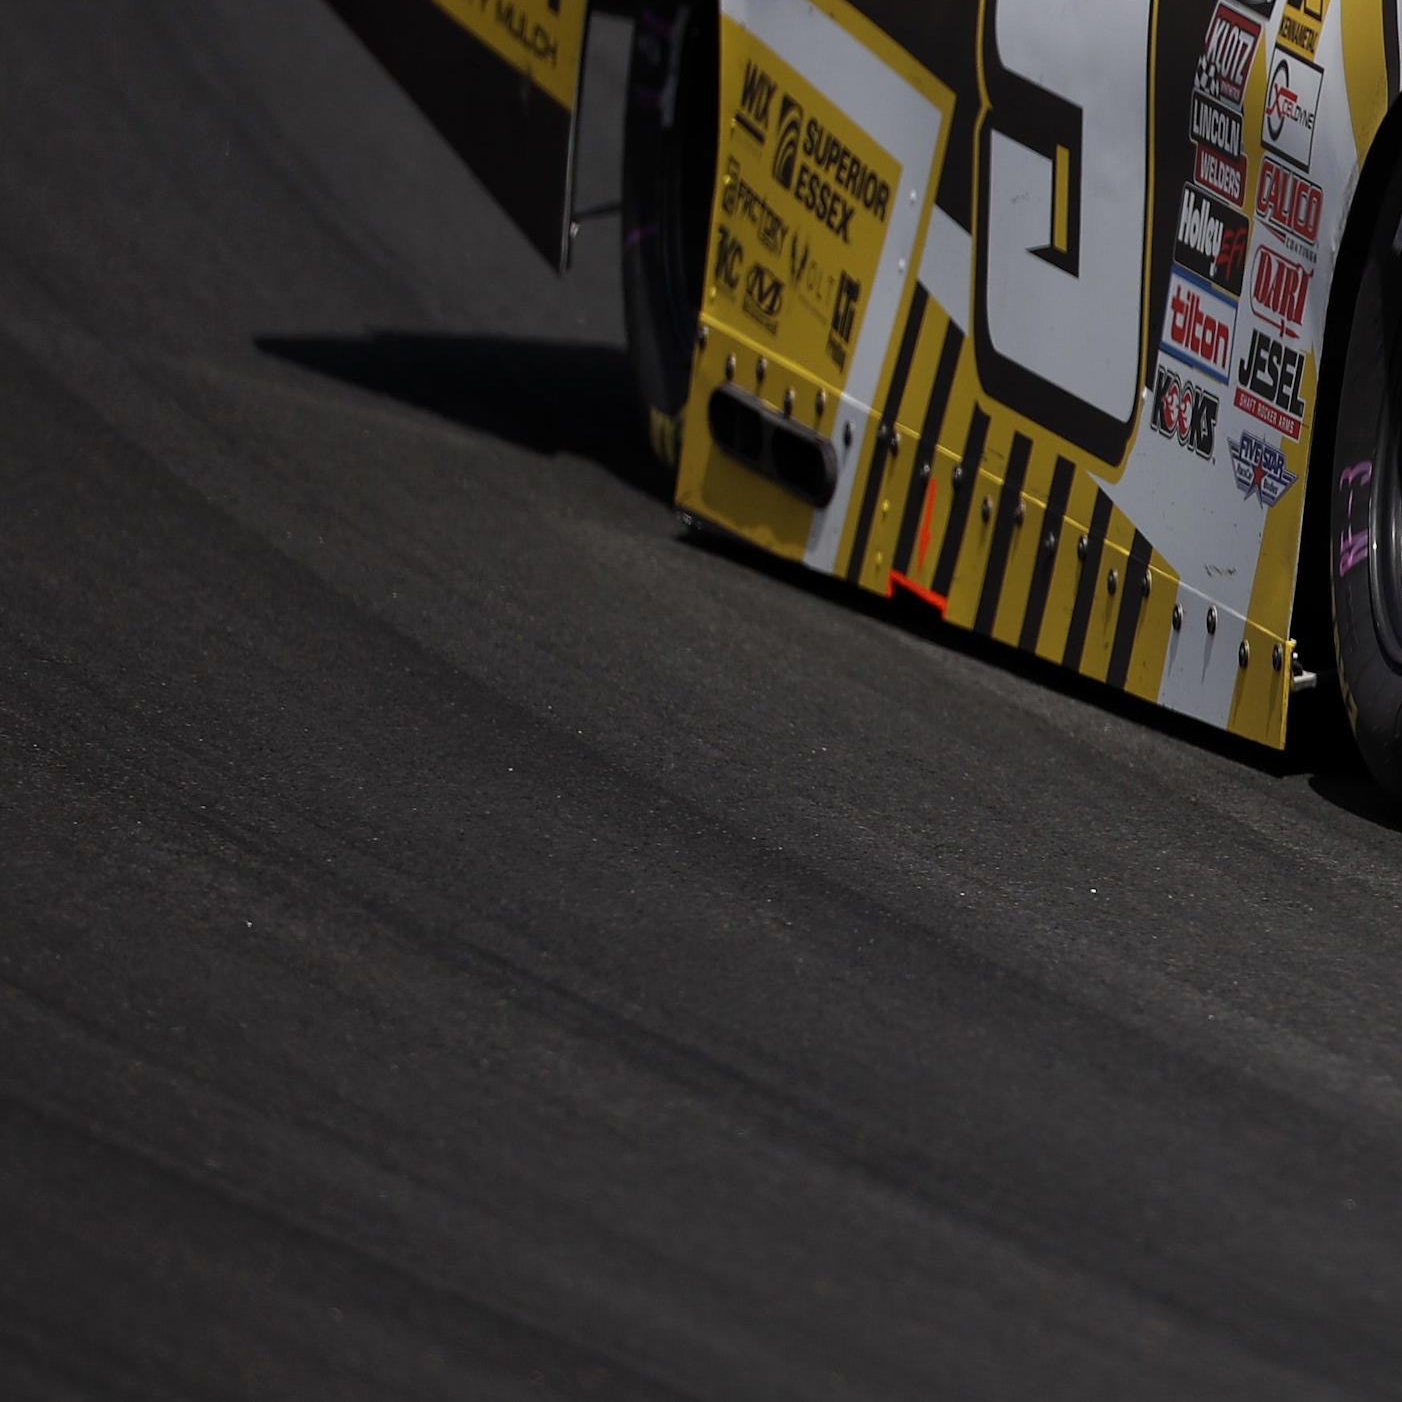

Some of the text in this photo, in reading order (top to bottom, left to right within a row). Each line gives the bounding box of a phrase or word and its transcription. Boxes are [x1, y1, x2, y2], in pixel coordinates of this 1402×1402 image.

[1207, 16, 1256, 86] KLOTZ
[740, 58, 778, 132] WIX
[1192, 98, 1241, 157] LINCOLN
[1265, 82, 1315, 130] XCELDYNE
[793, 163, 855, 244] ESSEX
[803, 115, 891, 223] SUPERIOR
[1199, 150, 1242, 200] WELDERS
[1256, 158, 1324, 243] CALICO
[1177, 187, 1225, 278] Holley
[1171, 283, 1230, 369] tilton
[1253, 249, 1315, 326] DART
[1237, 328, 1306, 419] JESEL
[1151, 363, 1220, 464] KOOKS
[1238, 392, 1295, 435] SHAFT ROCKER ARMS
[1240, 432, 1286, 480] FIVE STAR
